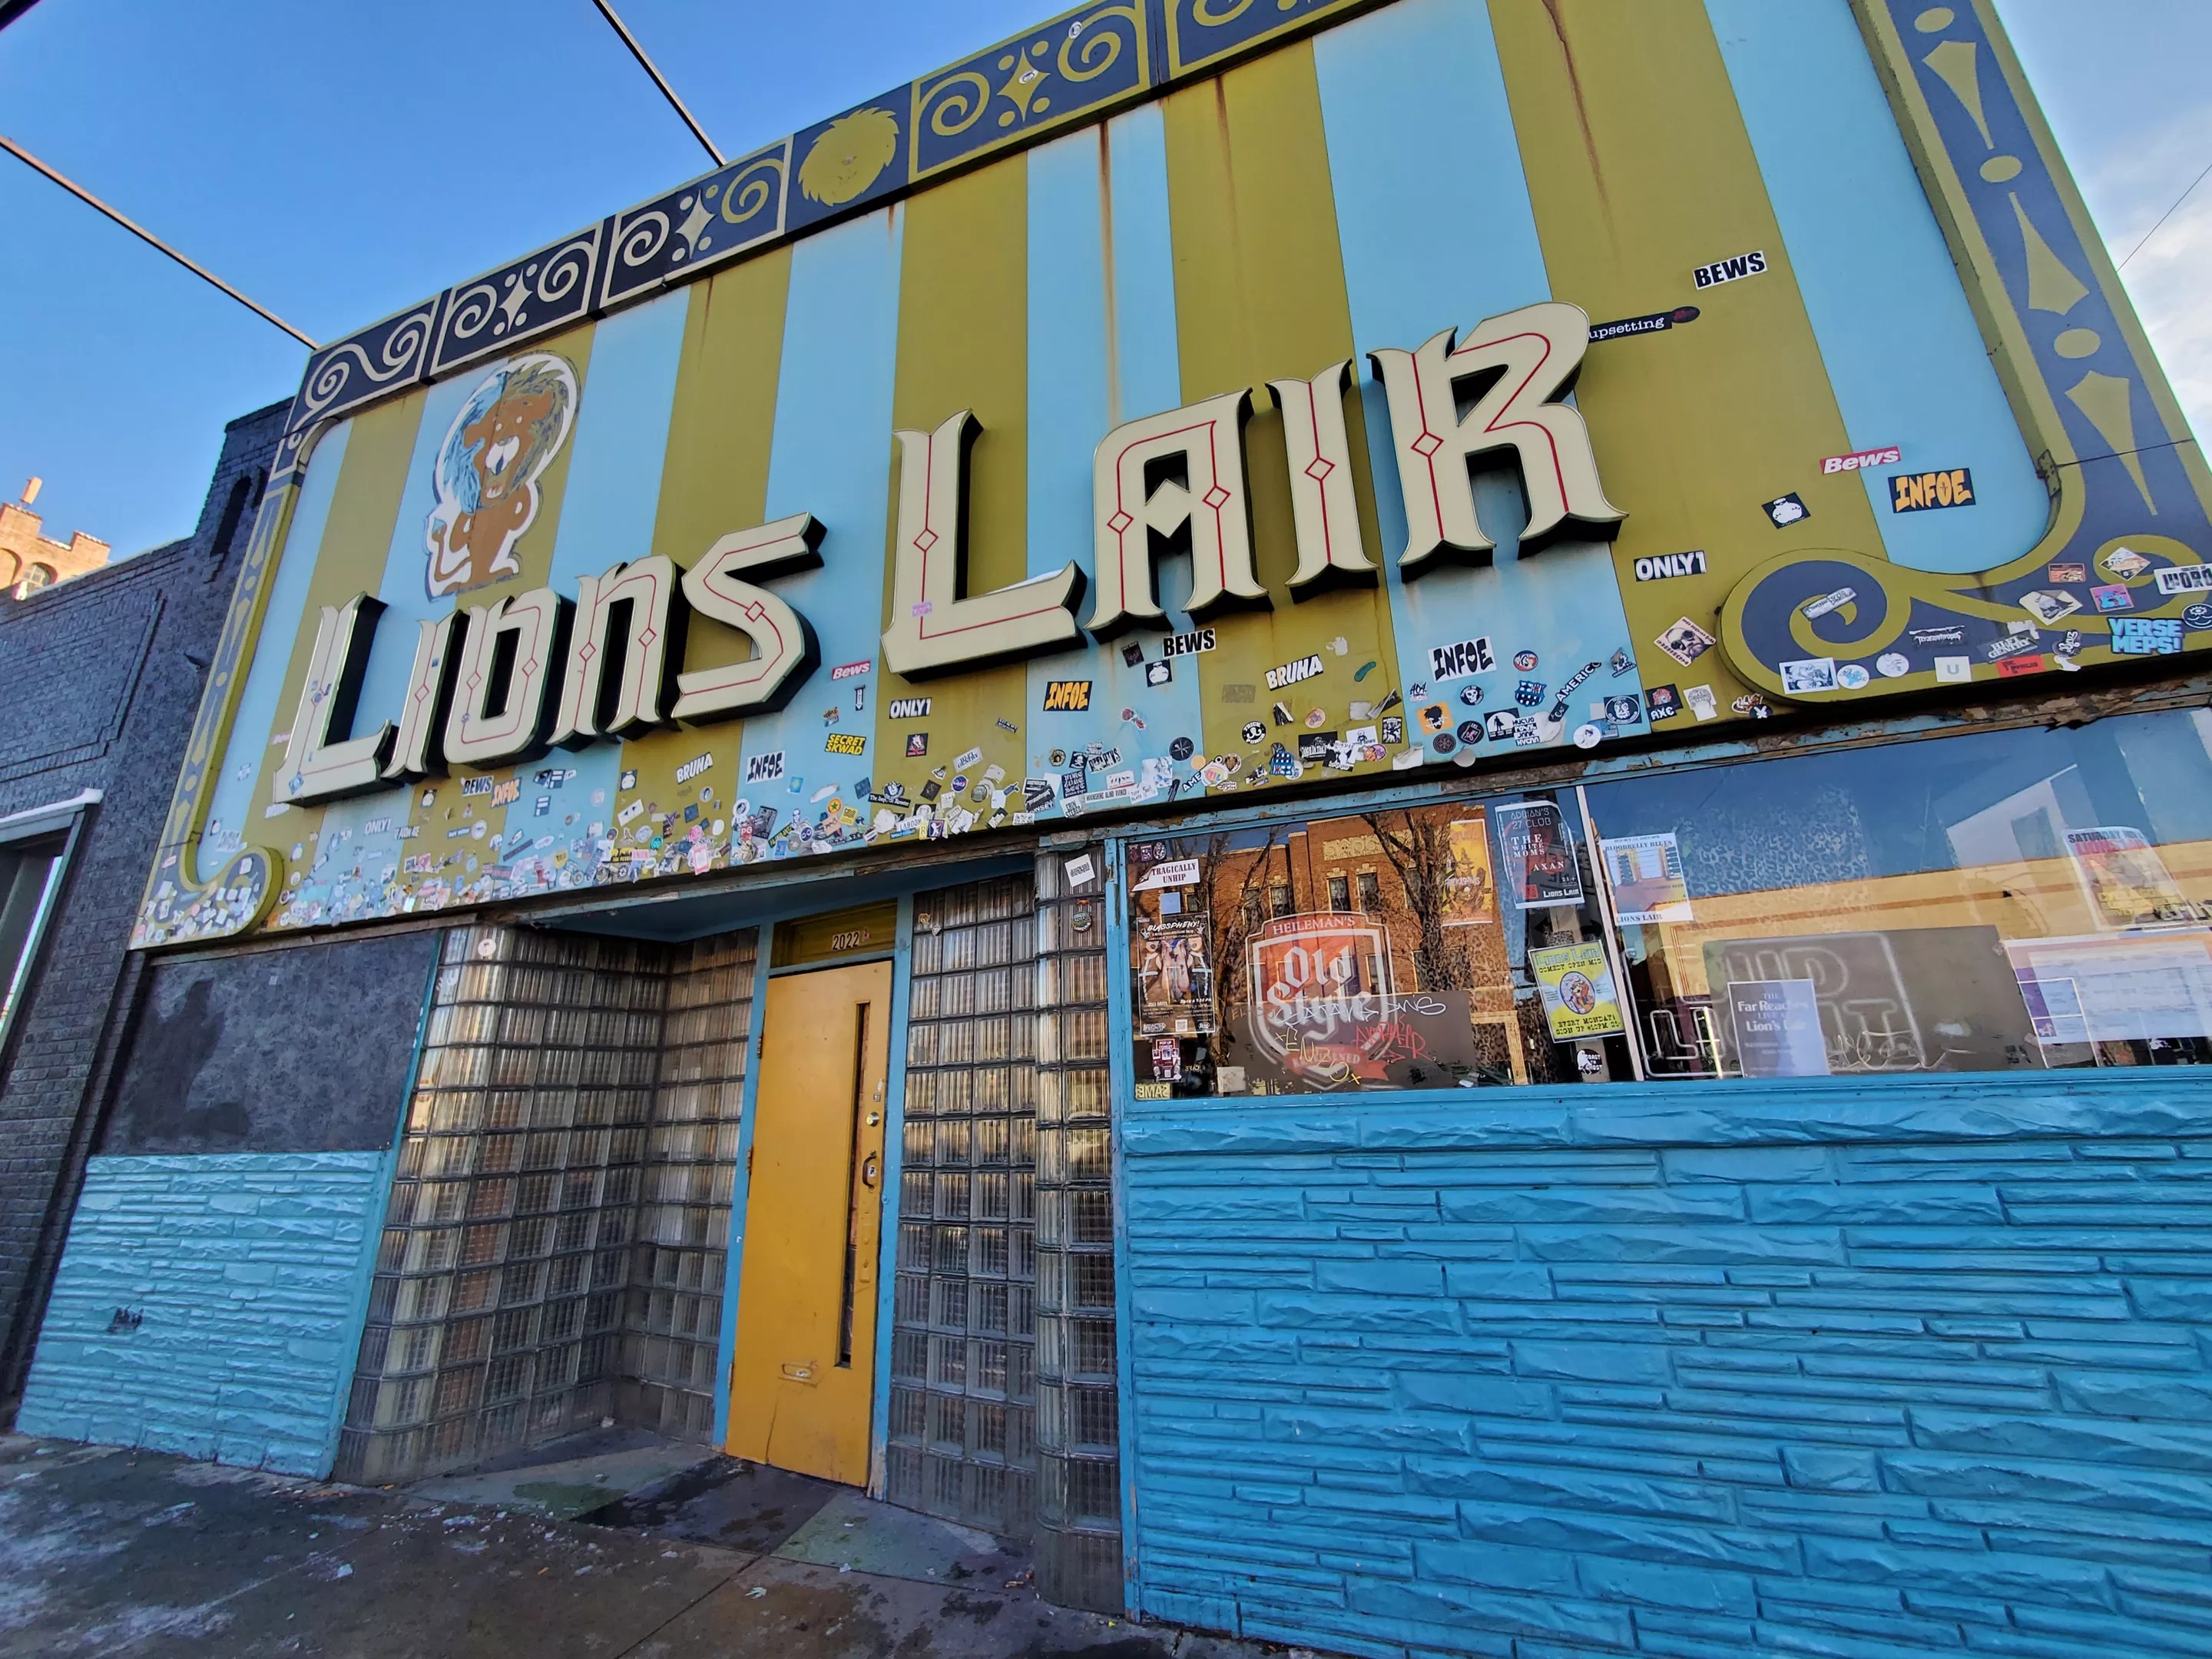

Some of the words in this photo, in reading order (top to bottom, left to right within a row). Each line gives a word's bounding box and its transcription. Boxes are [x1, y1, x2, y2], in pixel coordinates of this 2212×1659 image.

[1694, 253, 1765, 287] BEWS
[1588, 317, 1664, 339] upsetting
[1895, 469, 1972, 512] INFOE
[2108, 618, 2185, 637] VERSE
[1163, 629, 1215, 657] BEWS
[2111, 635, 2182, 654] MEPS!
[1433, 638, 1493, 681] INFOE
[833, 661, 870, 680] Bews
[1267, 655, 1323, 688] BRUHA
[1045, 682, 1088, 710] INFOE
[825, 743, 863, 755] SKWAD
[827, 734, 865, 747] SECRET
[676, 752, 713, 783] BRUHA
[747, 752, 783, 783] INFOE
[462, 777, 492, 795] BEWS
[1510, 807, 1550, 820] ADRIAN'S
[1512, 820, 1522, 830] 27
[1525, 817, 1551, 829] CLUB
[1511, 833, 1543, 845] THE
[1512, 842, 1545, 851] WHITE
[1513, 848, 1546, 859] MOMS
[1151, 861, 1197, 876] TRAGICALLY
[1533, 860, 1565, 872] AXAN
[1162, 873, 1187, 884] UNHIP
[1272, 915, 1356, 935] HEILEMAN'S
[832, 931, 859, 951] 2022
[1283, 945, 1353, 988] Old
[1538, 965, 1565, 973] COMEDY
[1568, 961, 1585, 969] OPEN
[1267, 987, 1373, 1041] Style
[1737, 1001, 1757, 1012] Far
[1558, 1018, 1580, 1027] EVERY
[1746, 1020, 1780, 1033] Lion's
